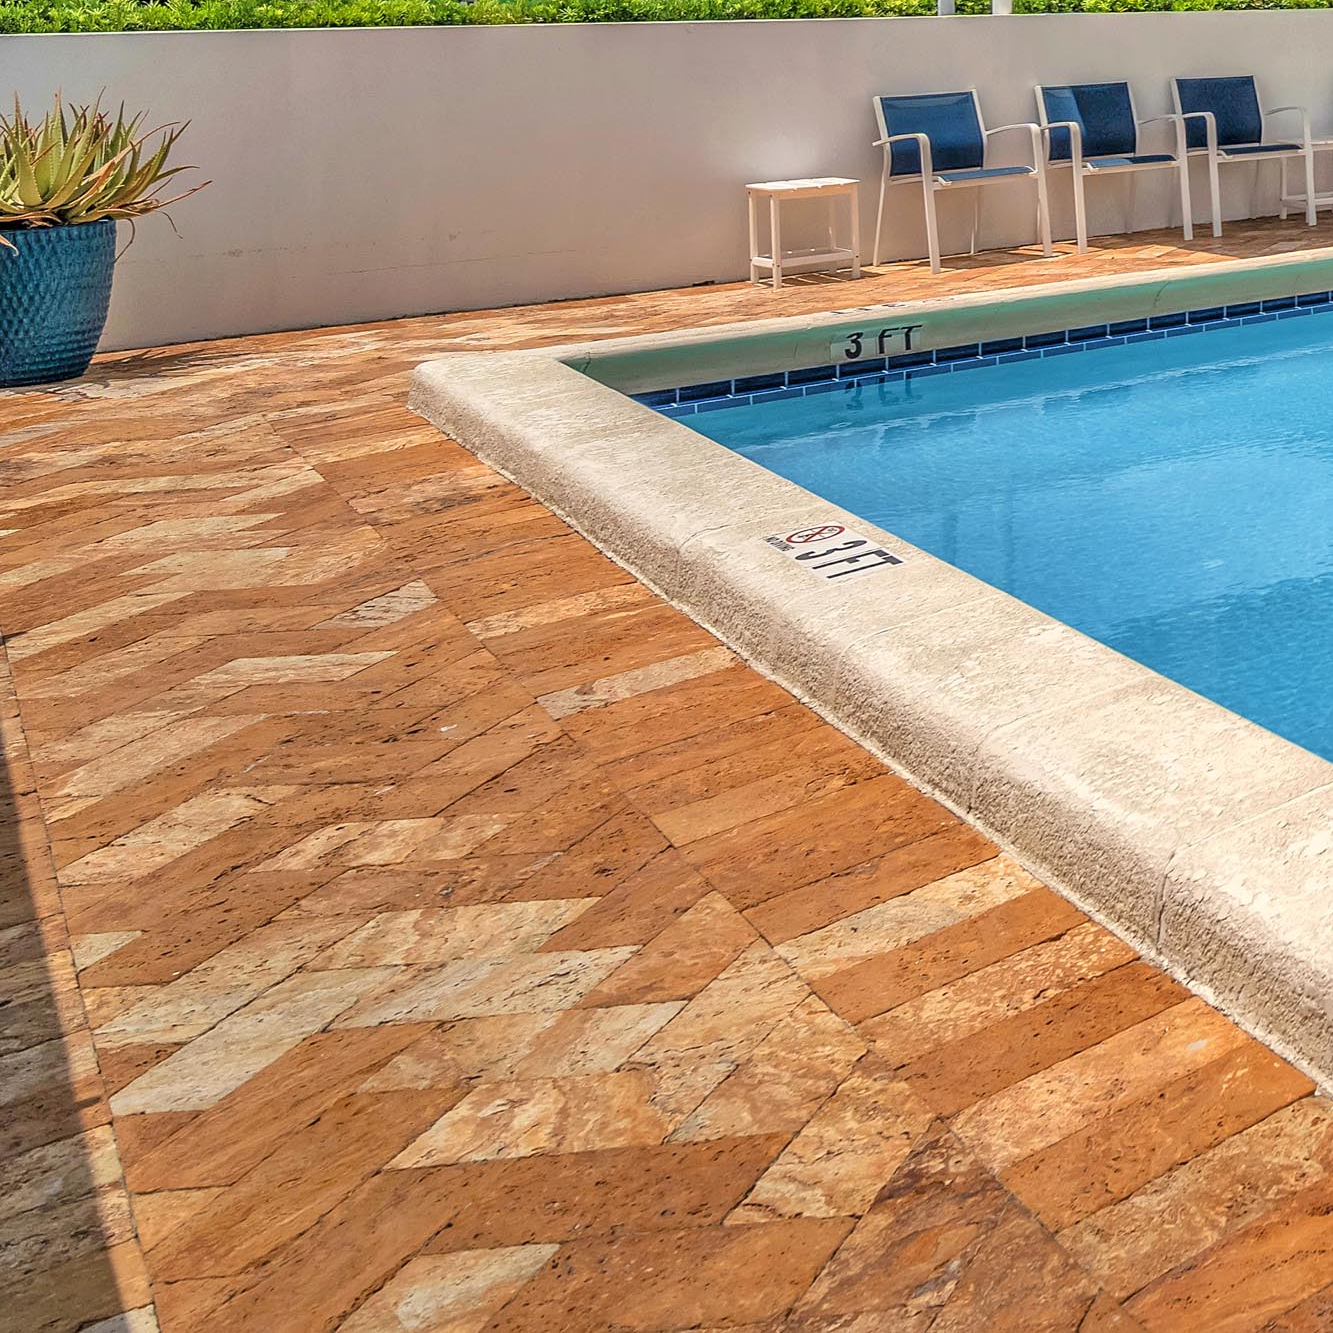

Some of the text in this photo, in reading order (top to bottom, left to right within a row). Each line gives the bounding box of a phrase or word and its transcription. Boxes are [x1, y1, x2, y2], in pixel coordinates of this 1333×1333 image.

[844, 324, 923, 359] 3 FT
[795, 539, 904, 579] 3 FT
